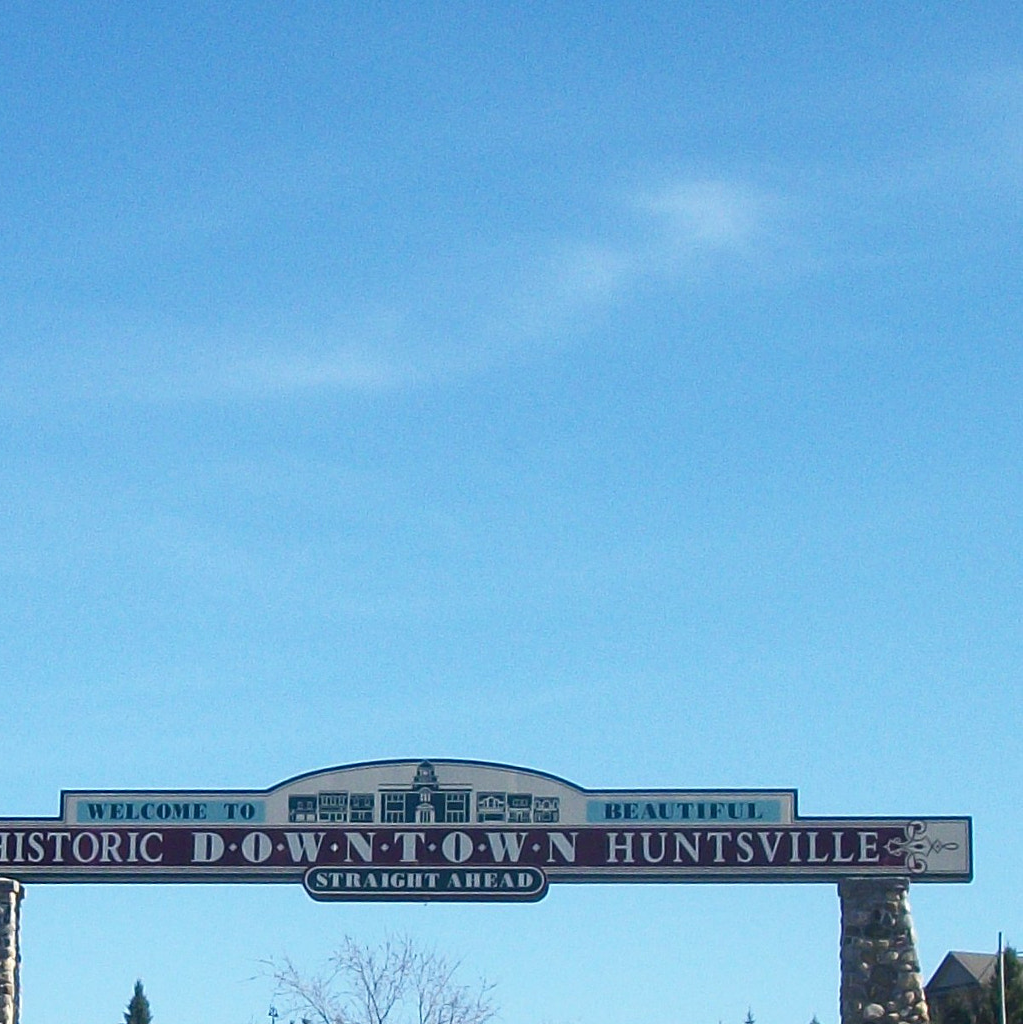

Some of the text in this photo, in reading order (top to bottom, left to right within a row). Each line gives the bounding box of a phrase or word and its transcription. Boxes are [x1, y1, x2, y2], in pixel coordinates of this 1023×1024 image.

[87, 802, 763, 820] WELCOME TO BEAUTIFUL
[605, 831, 880, 863] HUNTSVILLE
[315, 872, 533, 888] STRAIGHT AHEAD
